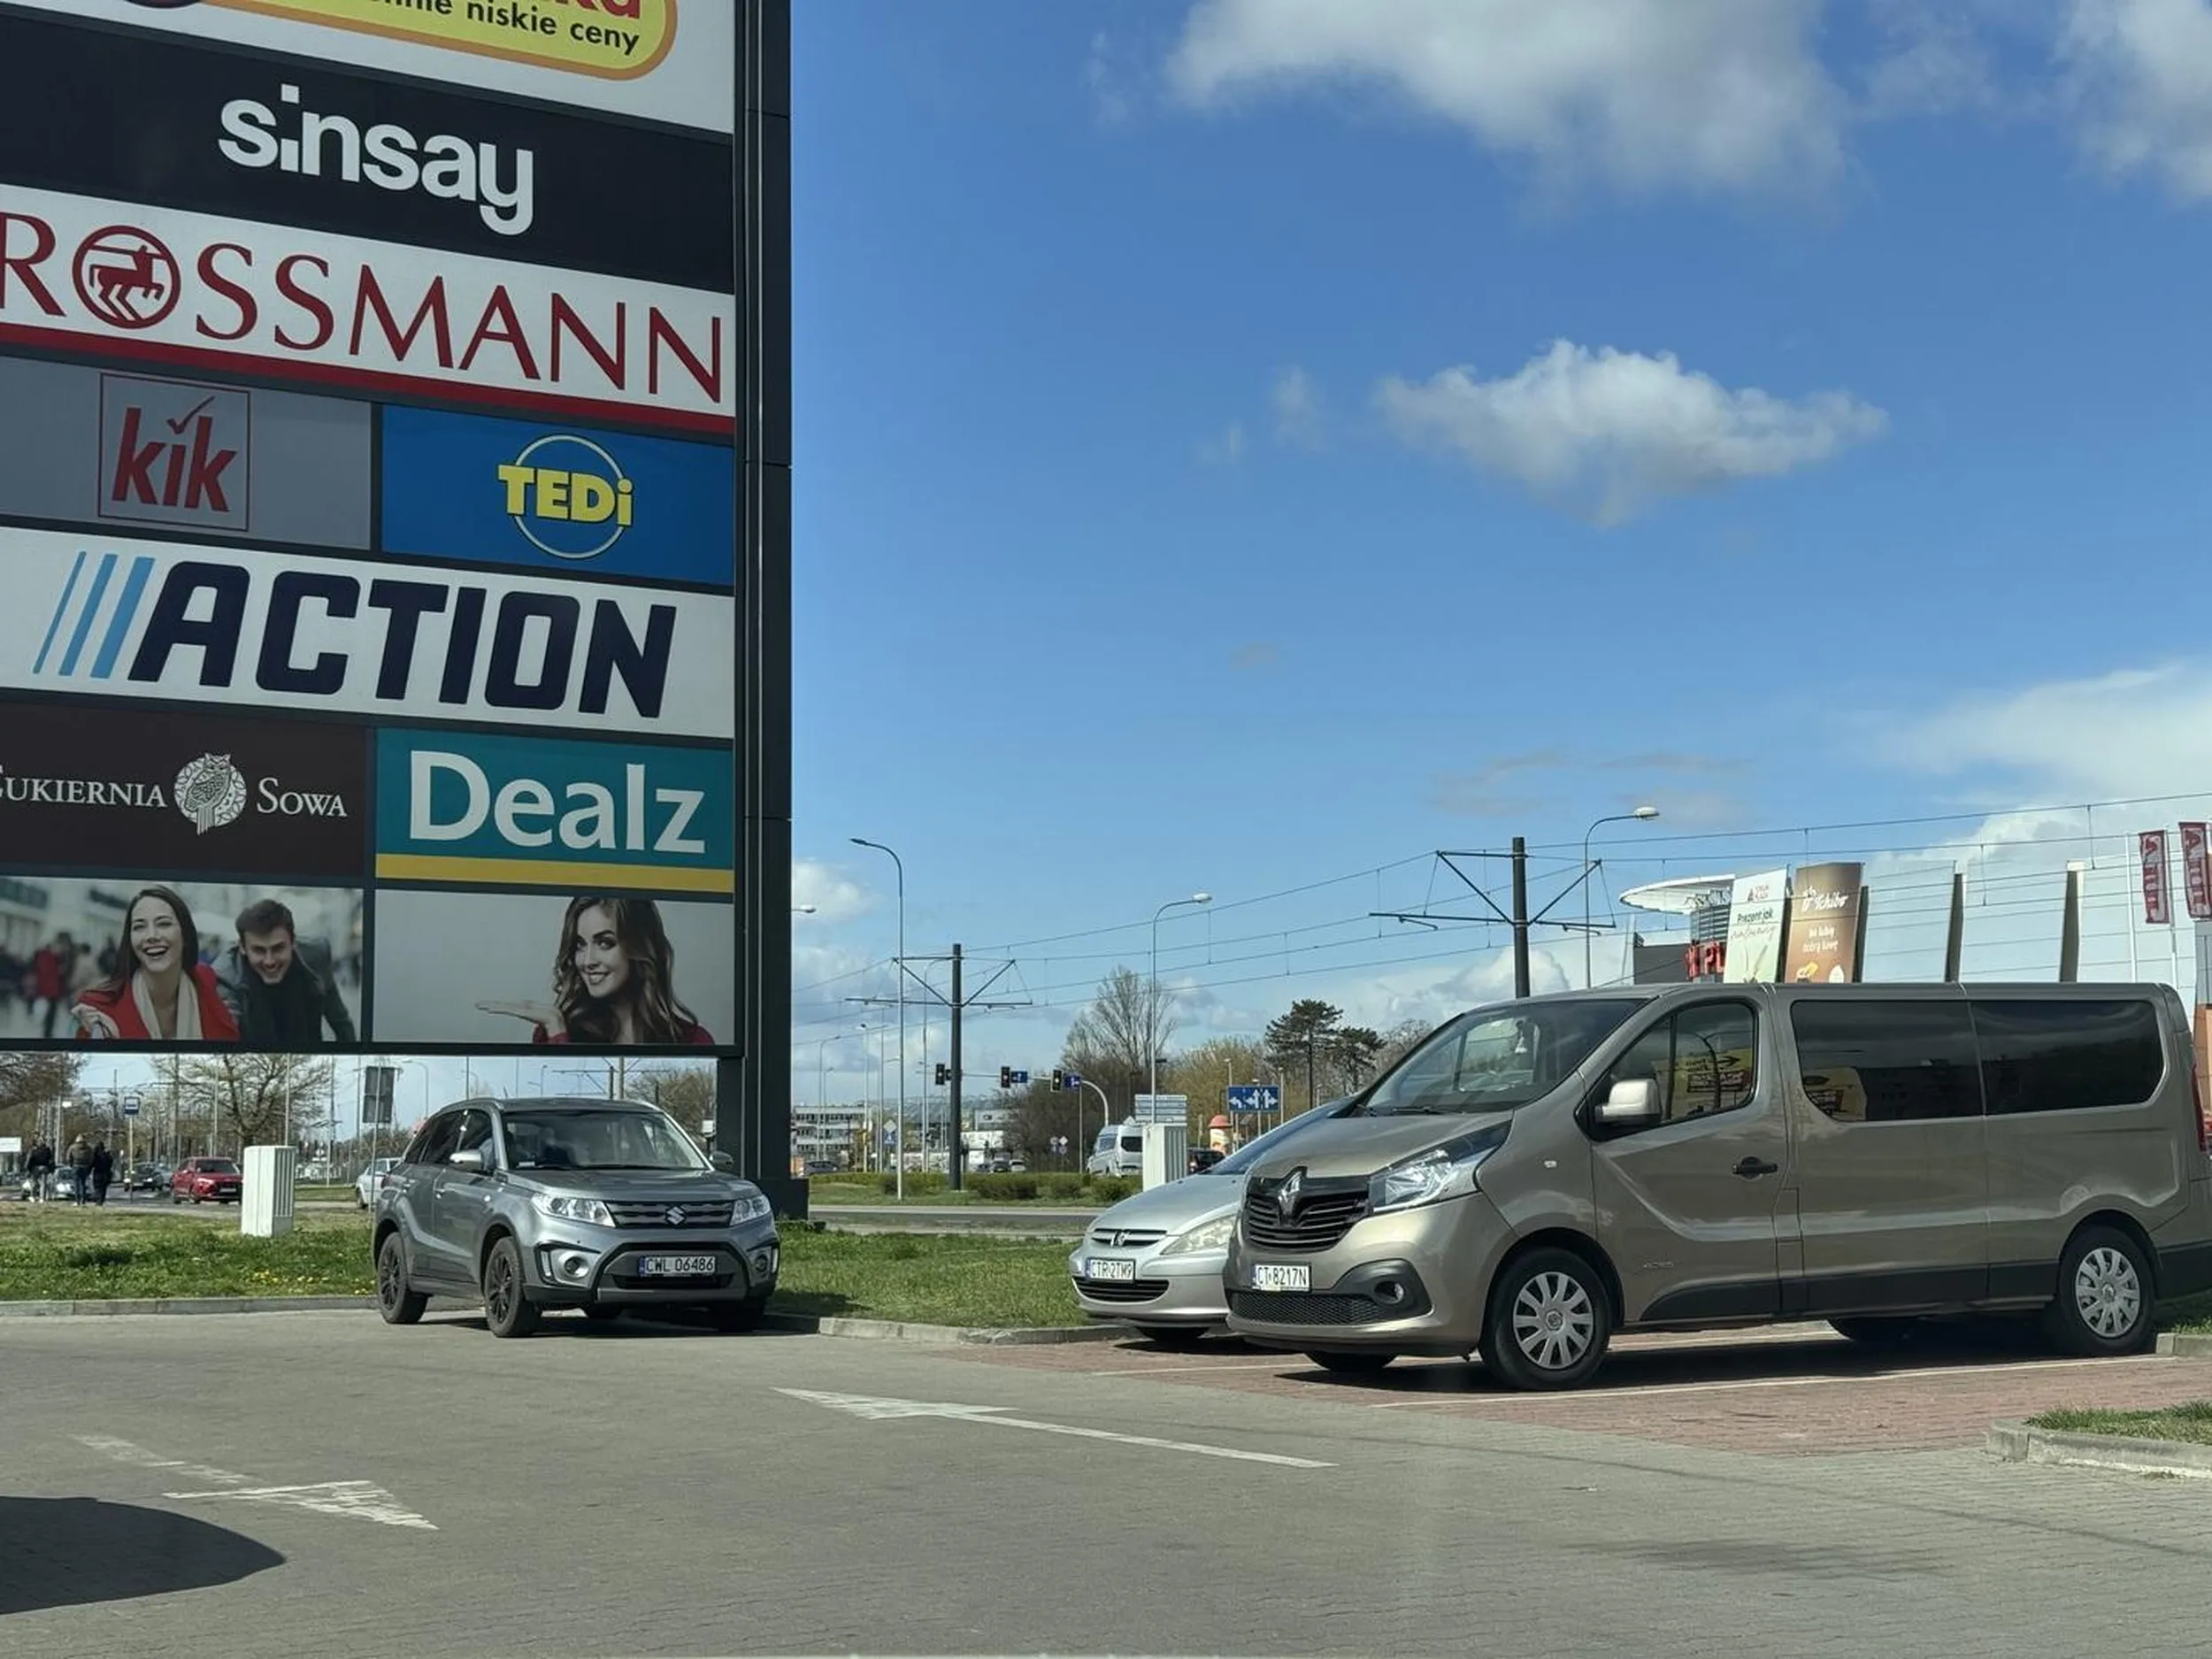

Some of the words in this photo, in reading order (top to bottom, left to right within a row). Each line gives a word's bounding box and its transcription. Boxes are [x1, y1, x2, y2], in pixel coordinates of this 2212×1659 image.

[467, 0, 557, 35] niskie
[570, 21, 640, 55] ceny
[218, 84, 534, 235] sinsay
[0, 212, 721, 404] ROSSMANN
[497, 463, 634, 527] TEDi
[127, 560, 677, 718] ACTION
[0, 764, 167, 807] UKIERNIA
[409, 750, 706, 855] Dealz
[647, 1257, 671, 1272] CWL
[675, 1257, 714, 1271] 06486
[1257, 1266, 1269, 1285] CT
[1273, 1267, 1307, 1285] 8217N
